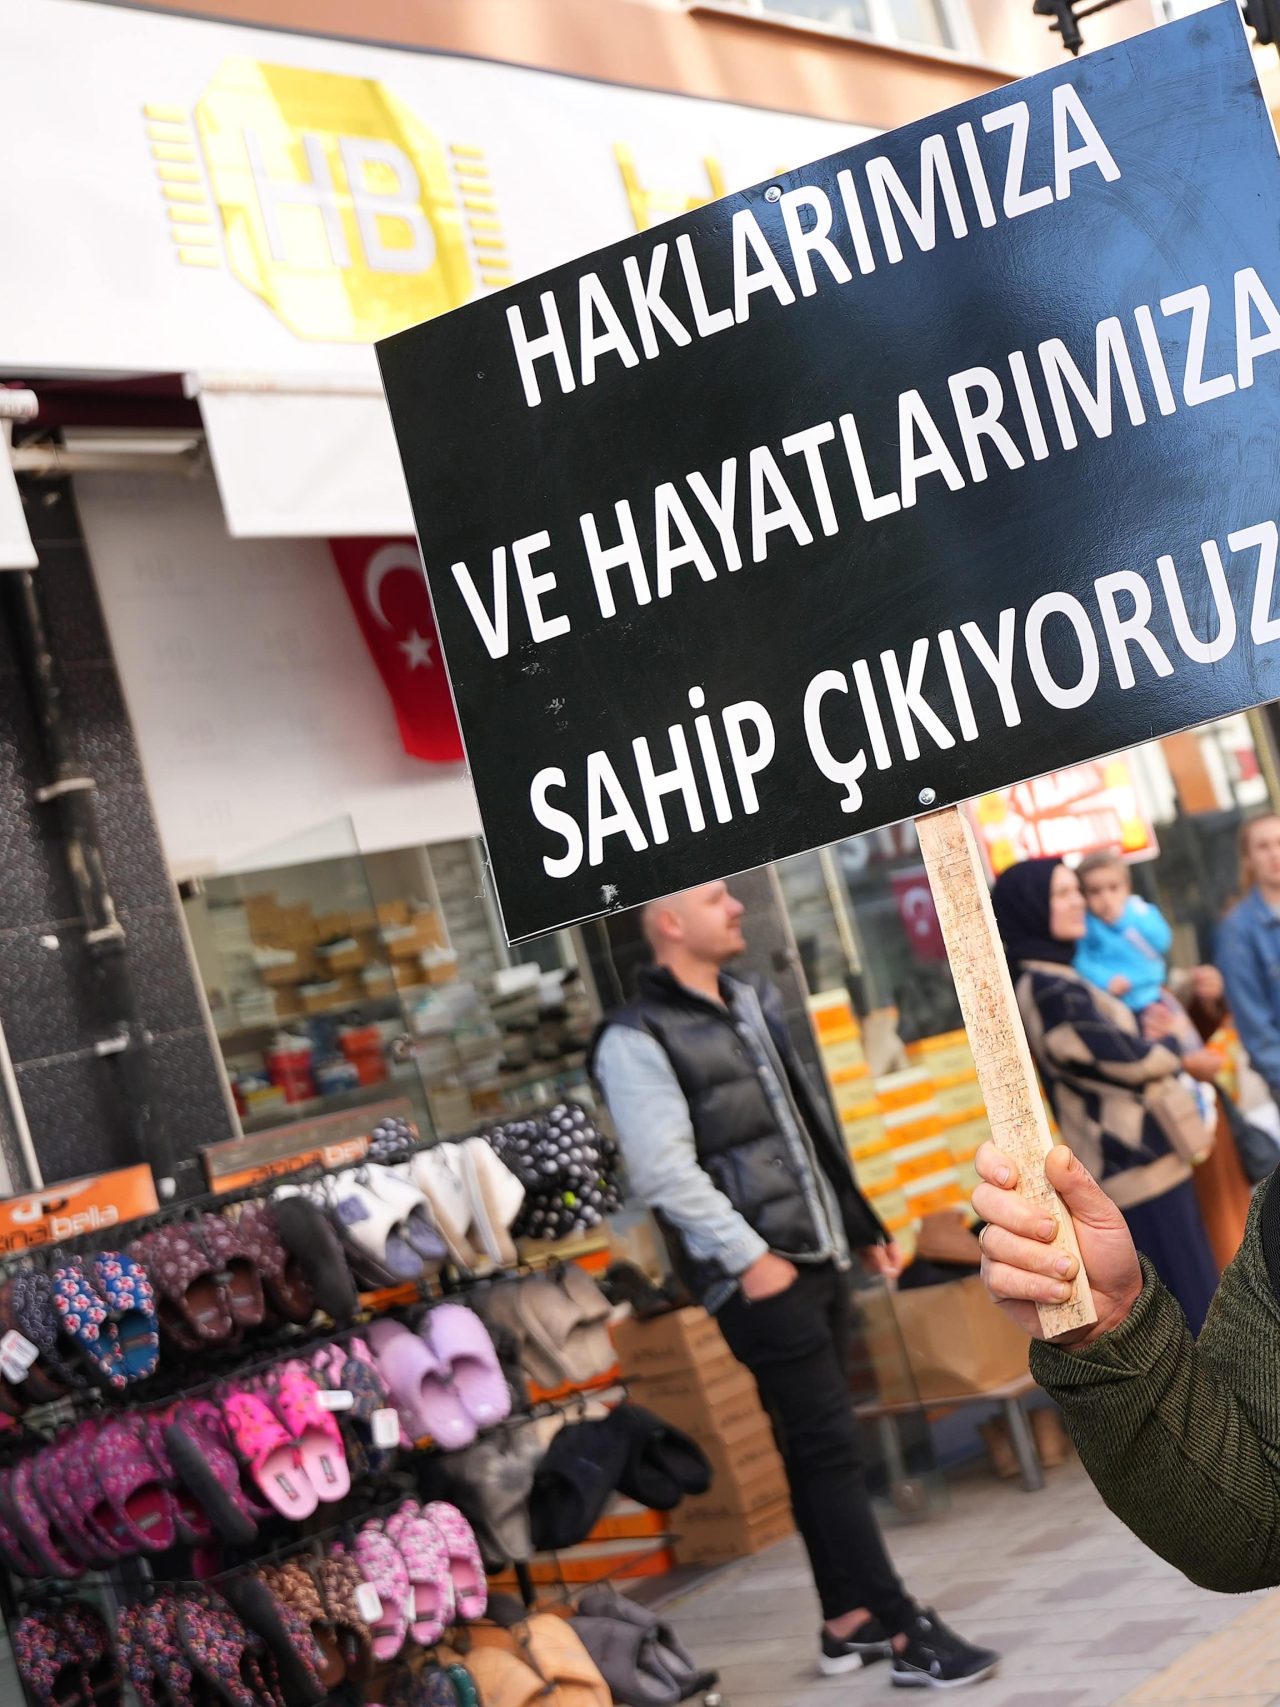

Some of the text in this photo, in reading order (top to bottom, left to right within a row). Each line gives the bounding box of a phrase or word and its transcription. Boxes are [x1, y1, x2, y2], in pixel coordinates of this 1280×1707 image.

[240, 128, 438, 275] HB
[505, 83, 1122, 408] HAKLARIMIZA
[451, 530, 571, 660] VE
[530, 686, 776, 879] SAHİP
